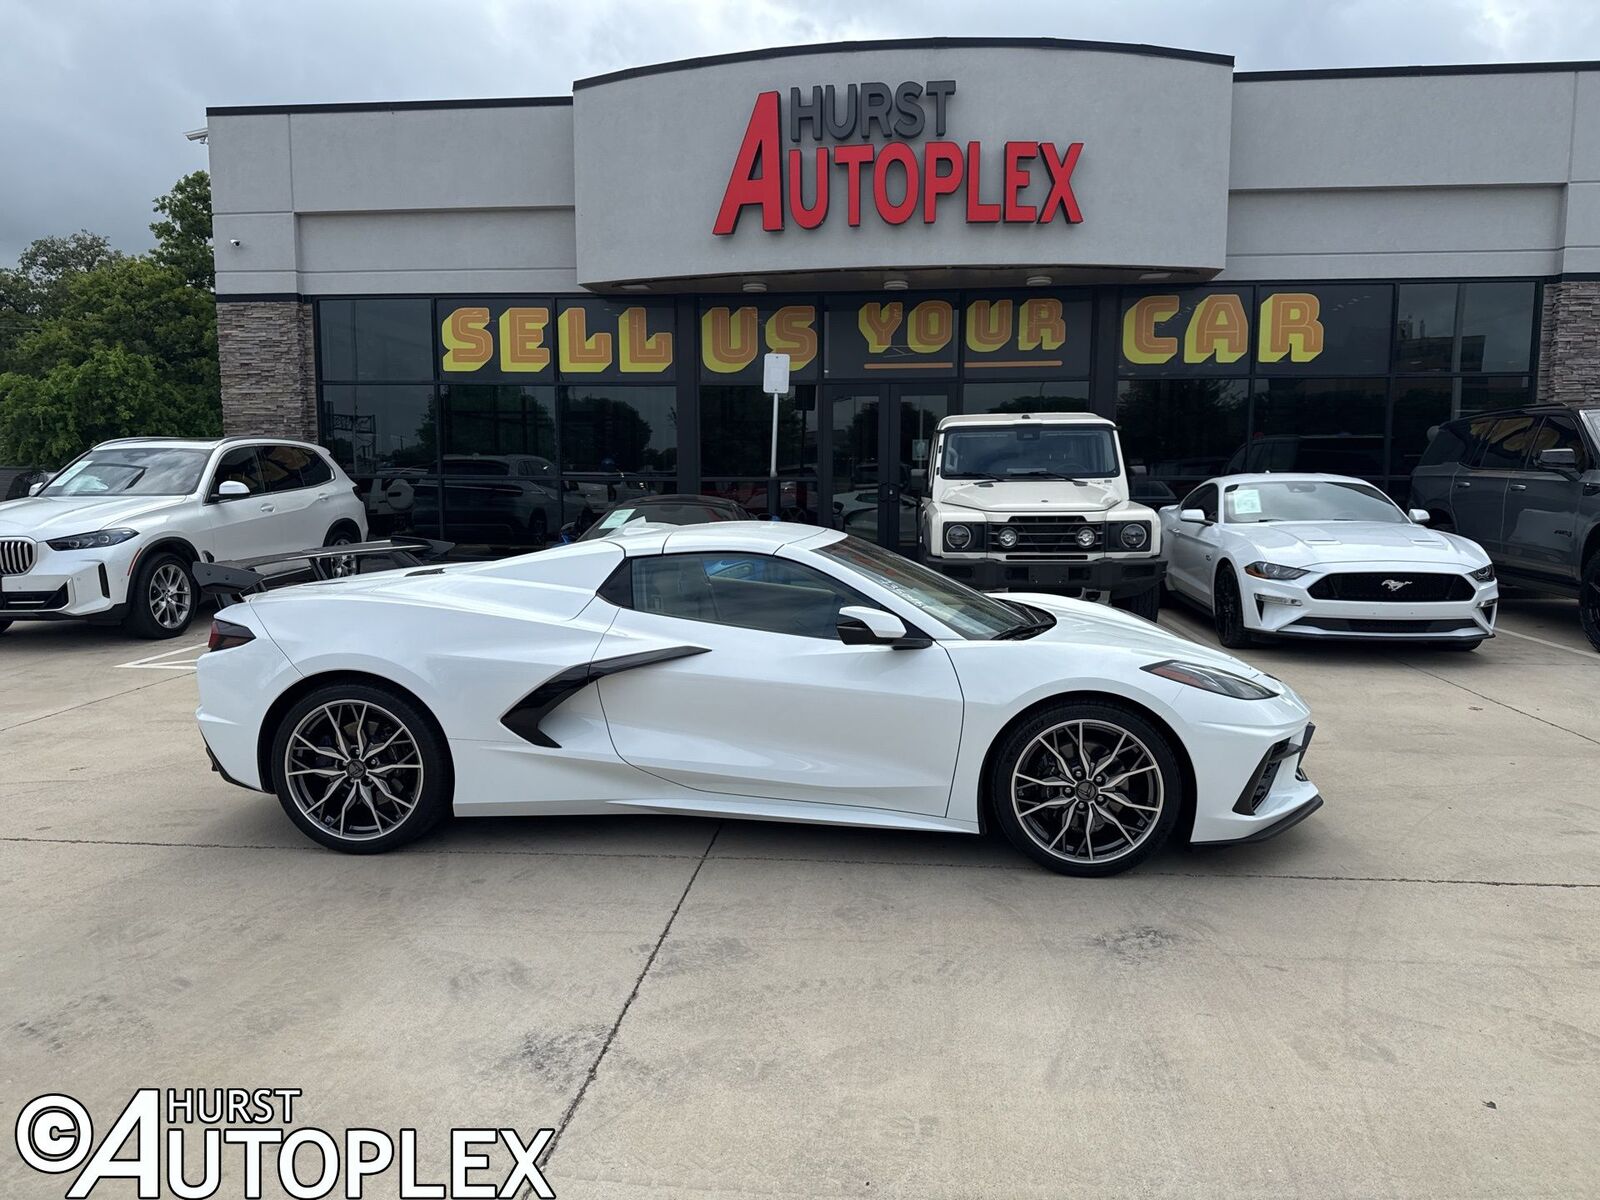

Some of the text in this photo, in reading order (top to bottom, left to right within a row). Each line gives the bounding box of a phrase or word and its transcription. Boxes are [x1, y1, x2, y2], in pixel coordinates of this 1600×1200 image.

[790, 80, 957, 142] HURST
[712, 90, 1084, 236] AUTOPLEX
[441, 293, 1324, 373] SELL US YOUR CAR
